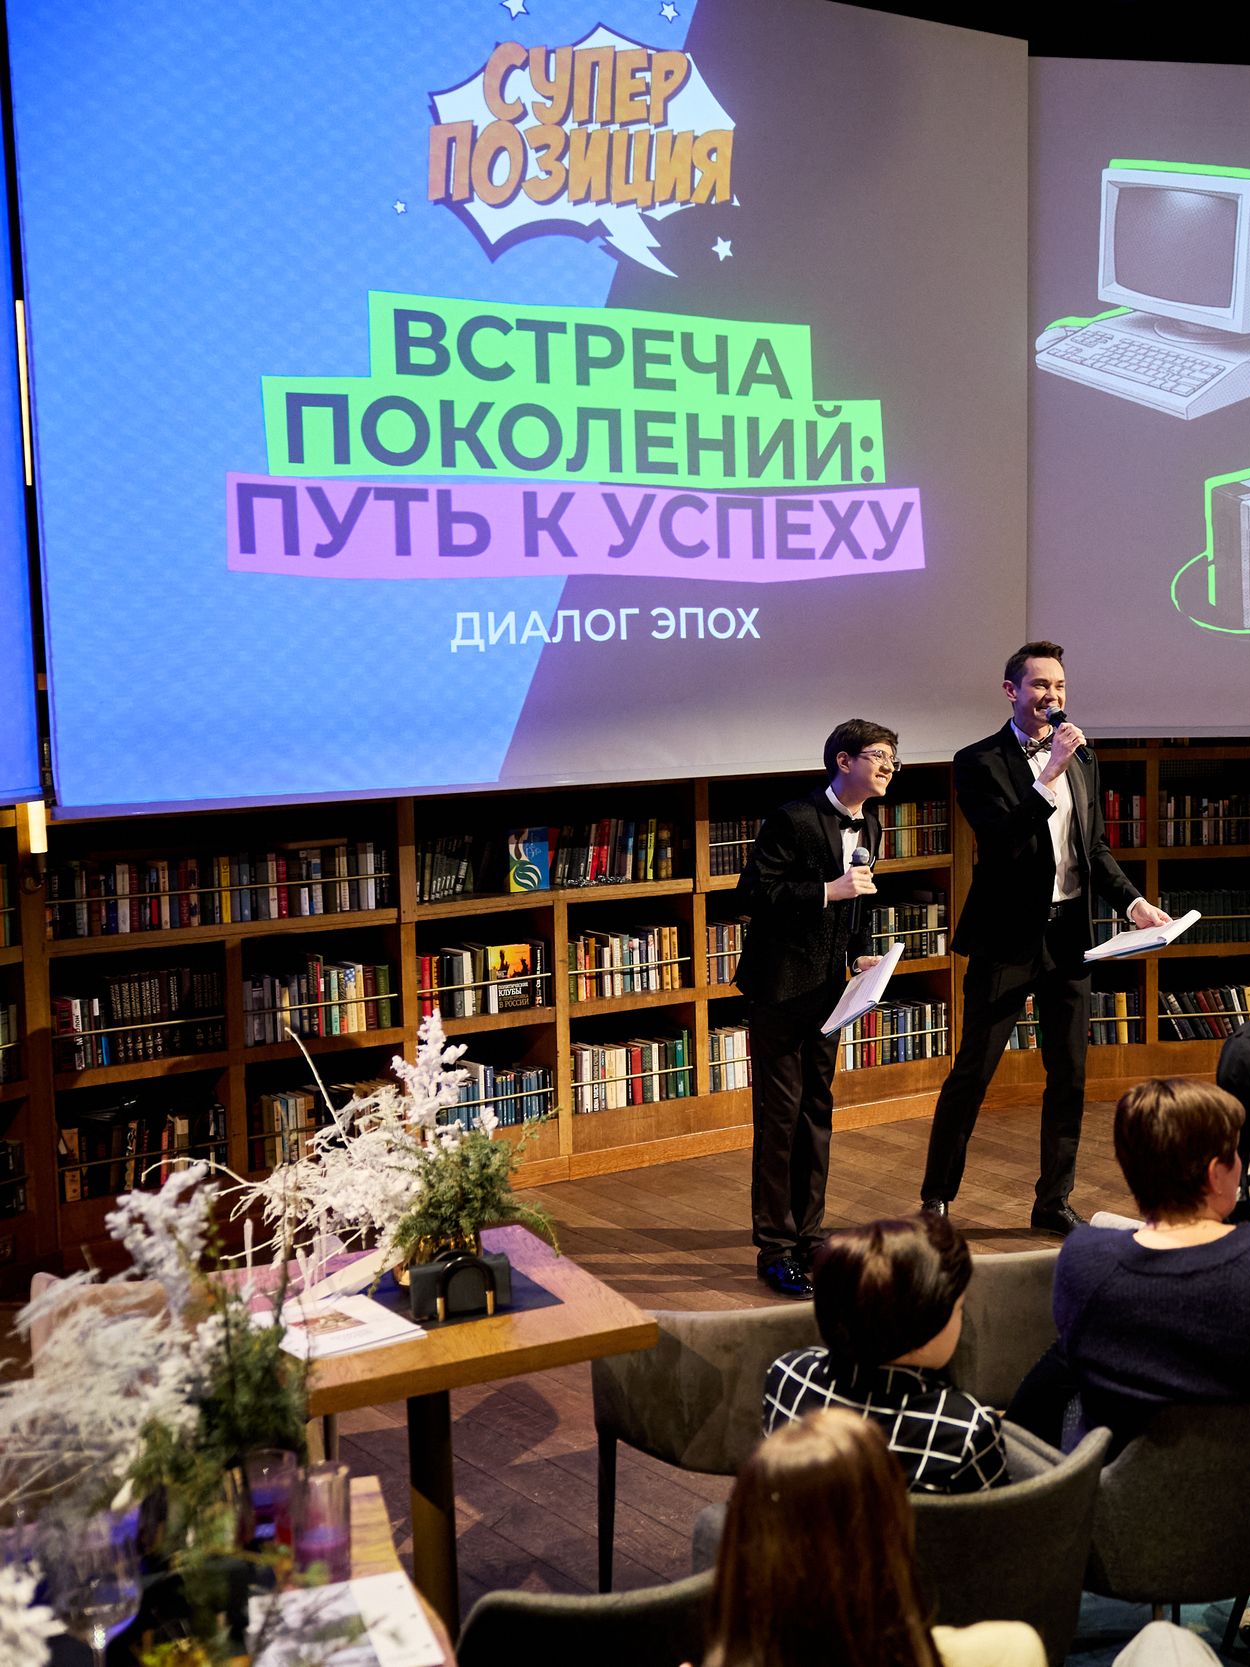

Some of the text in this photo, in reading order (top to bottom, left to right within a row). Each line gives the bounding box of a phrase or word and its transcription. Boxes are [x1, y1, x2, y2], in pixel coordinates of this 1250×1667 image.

[482, 40, 691, 128] СУПЕР
[426, 117, 737, 208] ПОЗИЦИЯ
[392, 307, 791, 399] ВСТРЕЧА
[284, 392, 875, 482] ПОКОЛЕНИЙ:
[236, 483, 915, 562] ПУТЬ К УСПЕХУ
[450, 607, 761, 652] ДИАЛОГ ЭПОХ
[498, 988, 522, 997] КЛУБЫ
